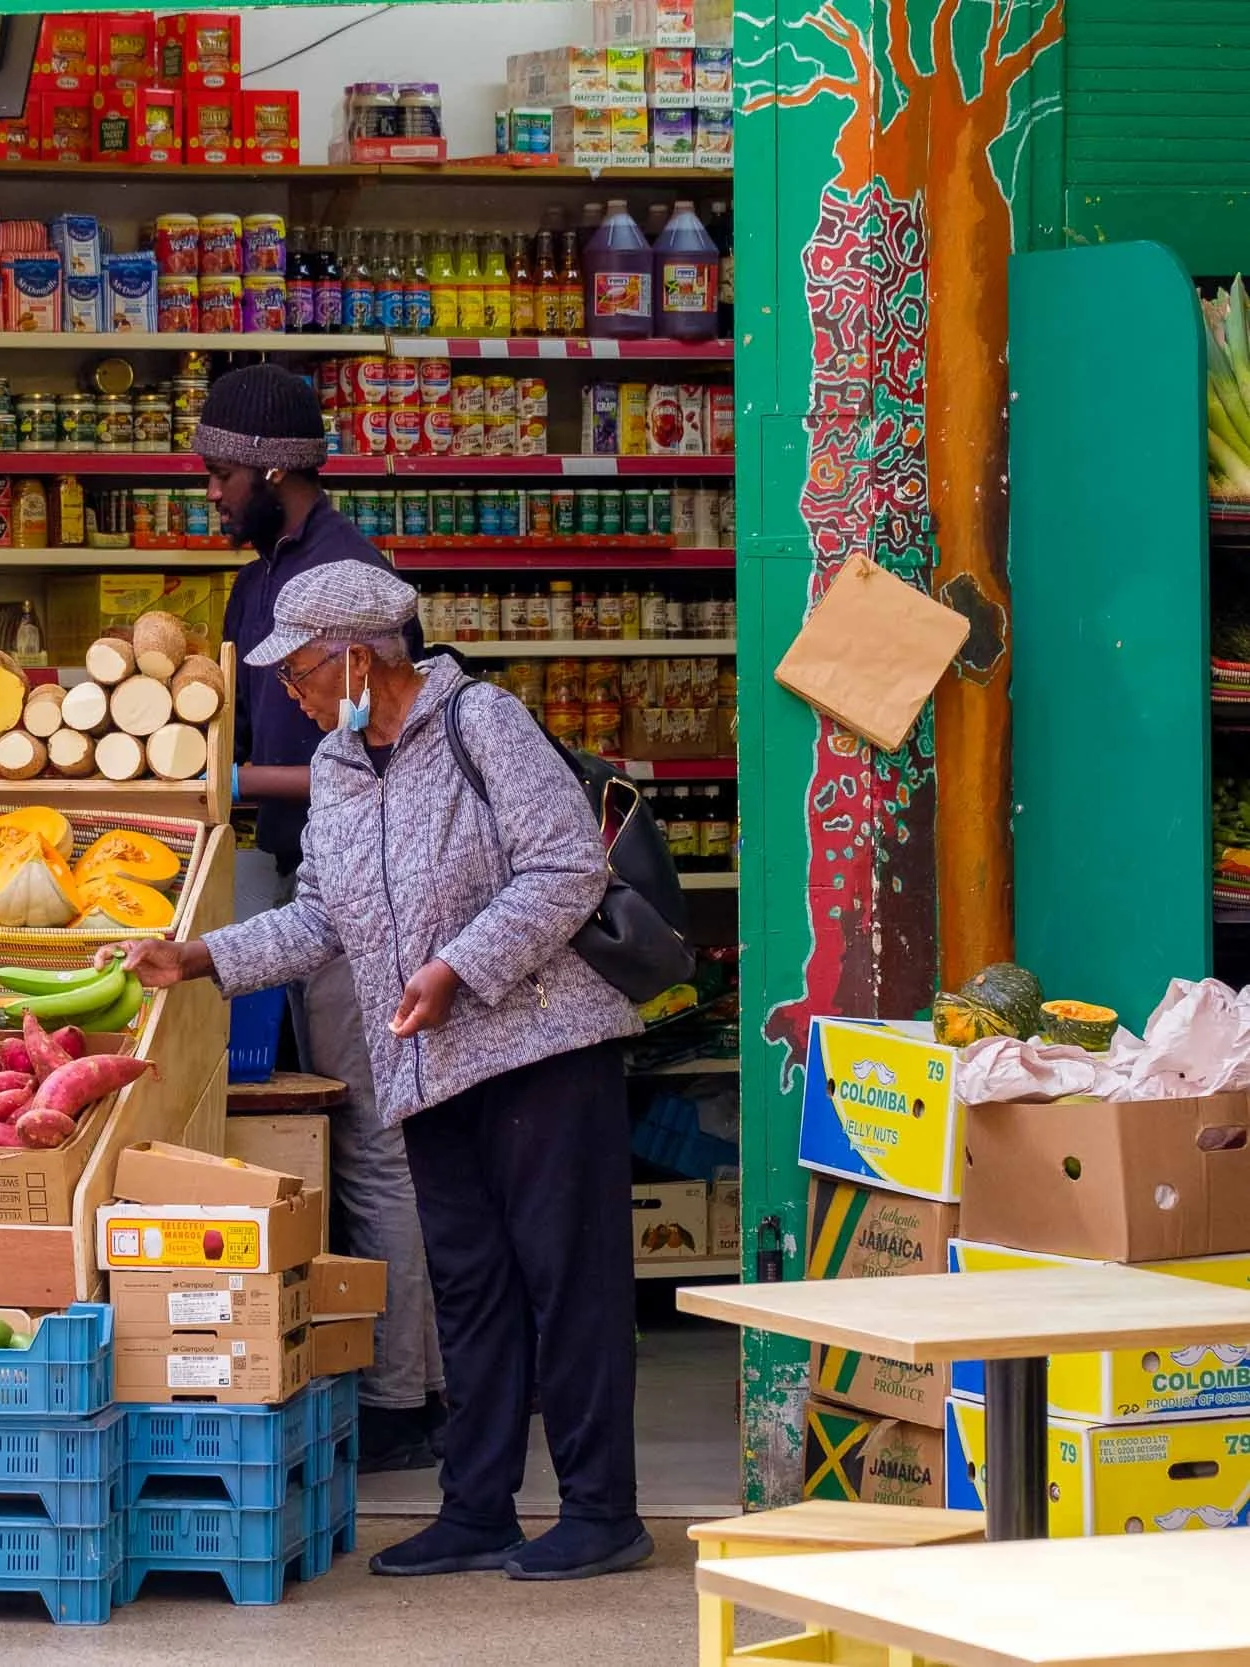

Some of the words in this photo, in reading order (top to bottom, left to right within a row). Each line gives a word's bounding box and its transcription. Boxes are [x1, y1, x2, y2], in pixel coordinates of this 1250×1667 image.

[928, 1060, 945, 1082] 79
[840, 1080, 908, 1114] COLOMBA
[873, 1126, 899, 1145] NUTS
[858, 1229, 924, 1261] JAMAICA
[873, 1378, 925, 1403] PRODUCE
[1152, 1366, 1250, 1393] COLOMB
[1118, 1404, 1140, 1416] 20
[1147, 1396, 1197, 1409] PRODUCT
[1198, 1394, 1214, 1407] OF
[1060, 1441, 1077, 1464] 79
[1225, 1434, 1250, 1456] 79
[869, 1458, 932, 1486] JAMAICA
